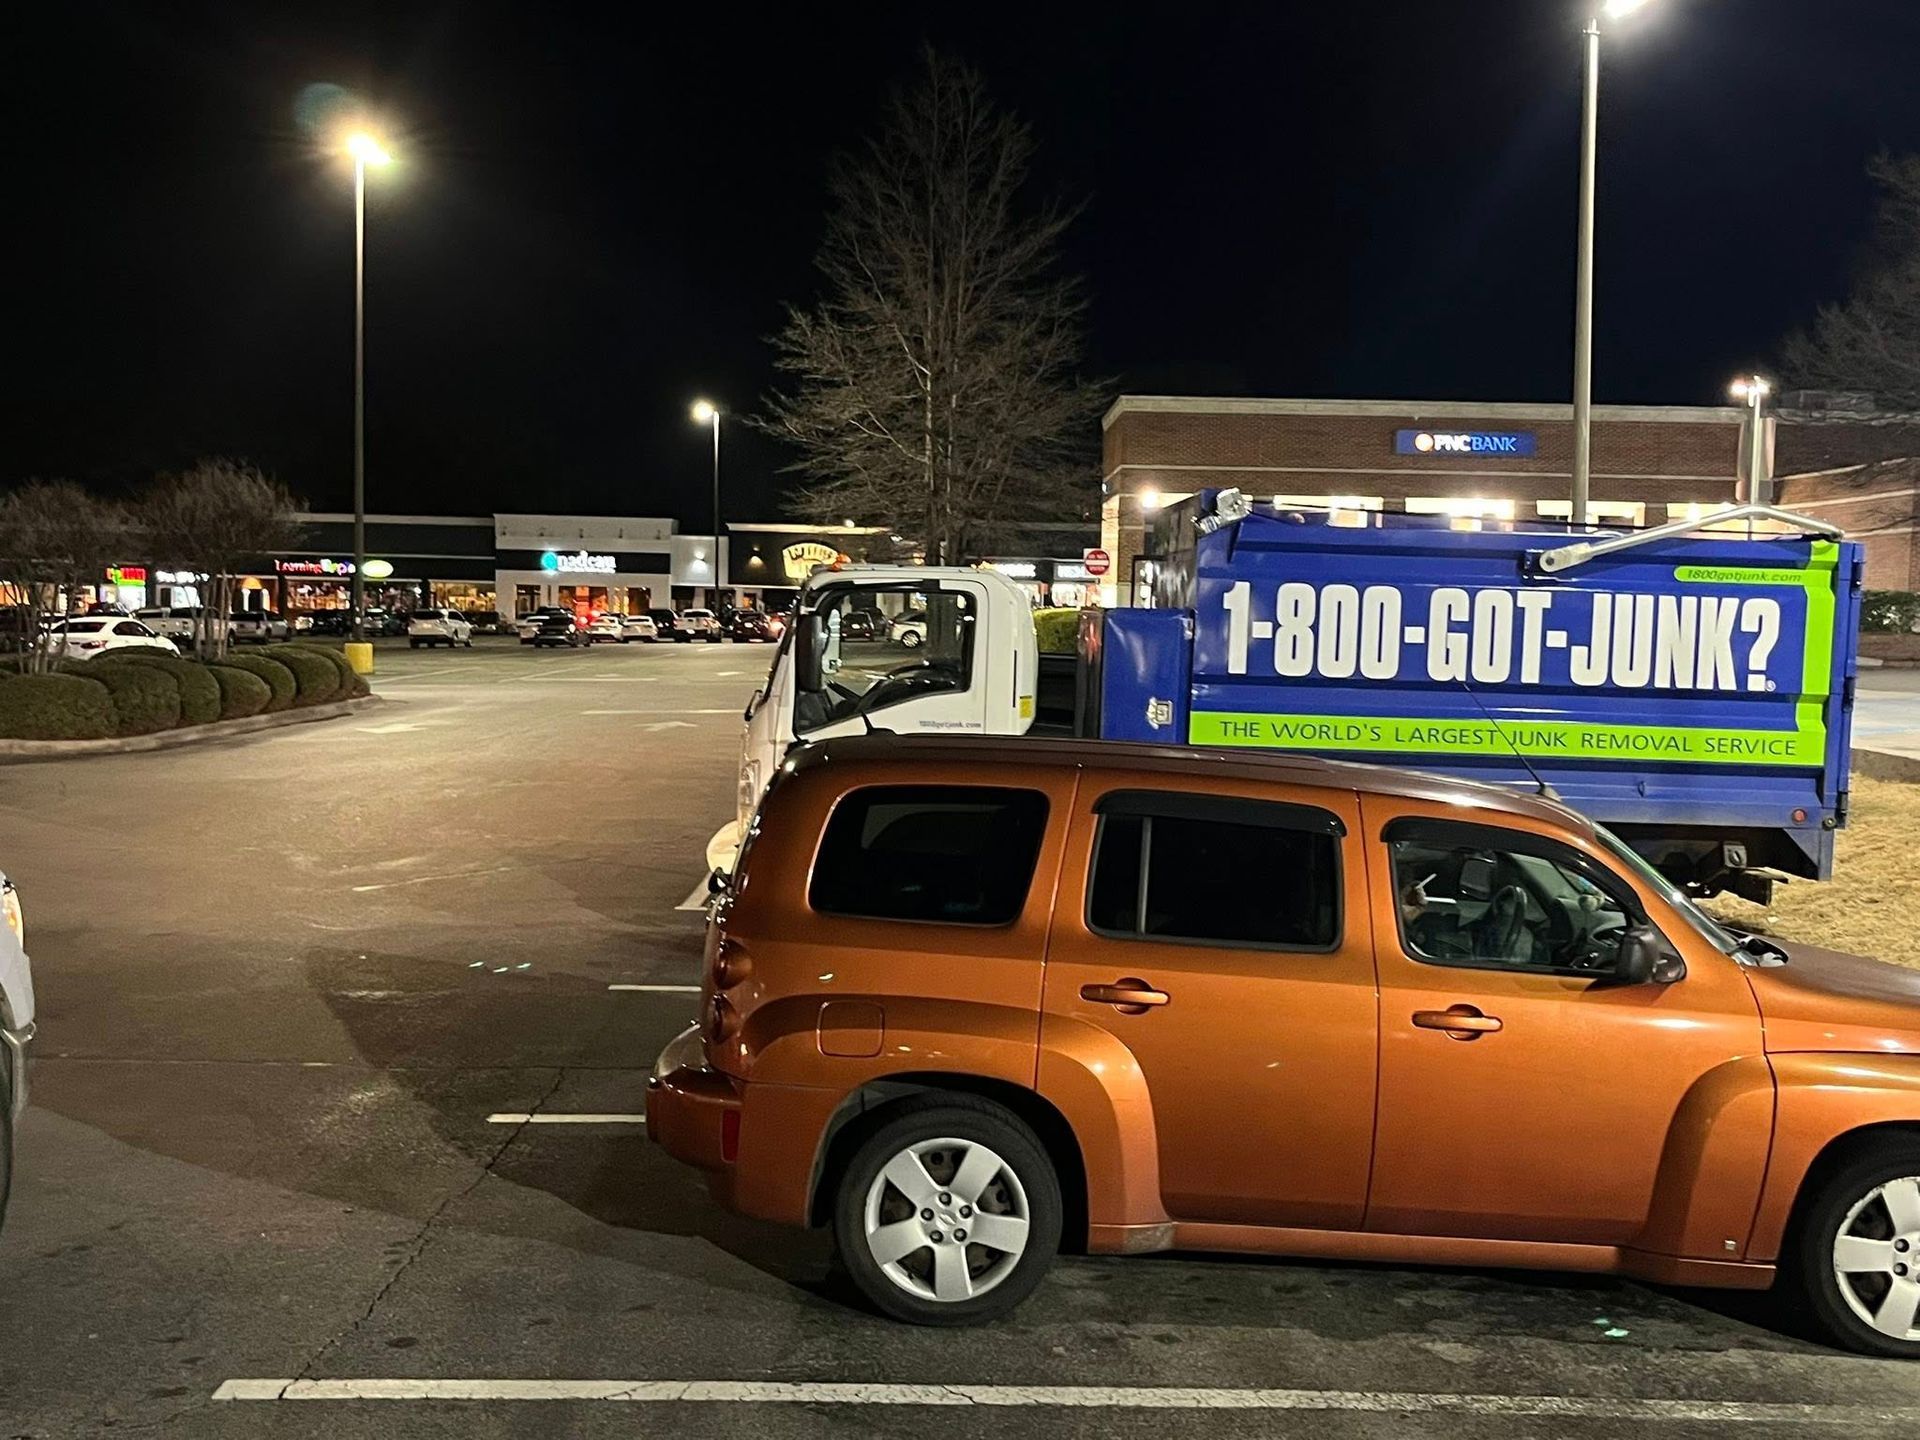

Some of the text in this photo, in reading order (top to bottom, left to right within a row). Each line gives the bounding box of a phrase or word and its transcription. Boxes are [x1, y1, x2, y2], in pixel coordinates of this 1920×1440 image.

[1687, 569, 1801, 582] 1800gotjunk.com
[1223, 581, 1780, 691] 1-800-GOT-JUNK?
[1220, 721, 1797, 755] THE WORLD'S LARGEST JUNK REMOVAL SERVICE
